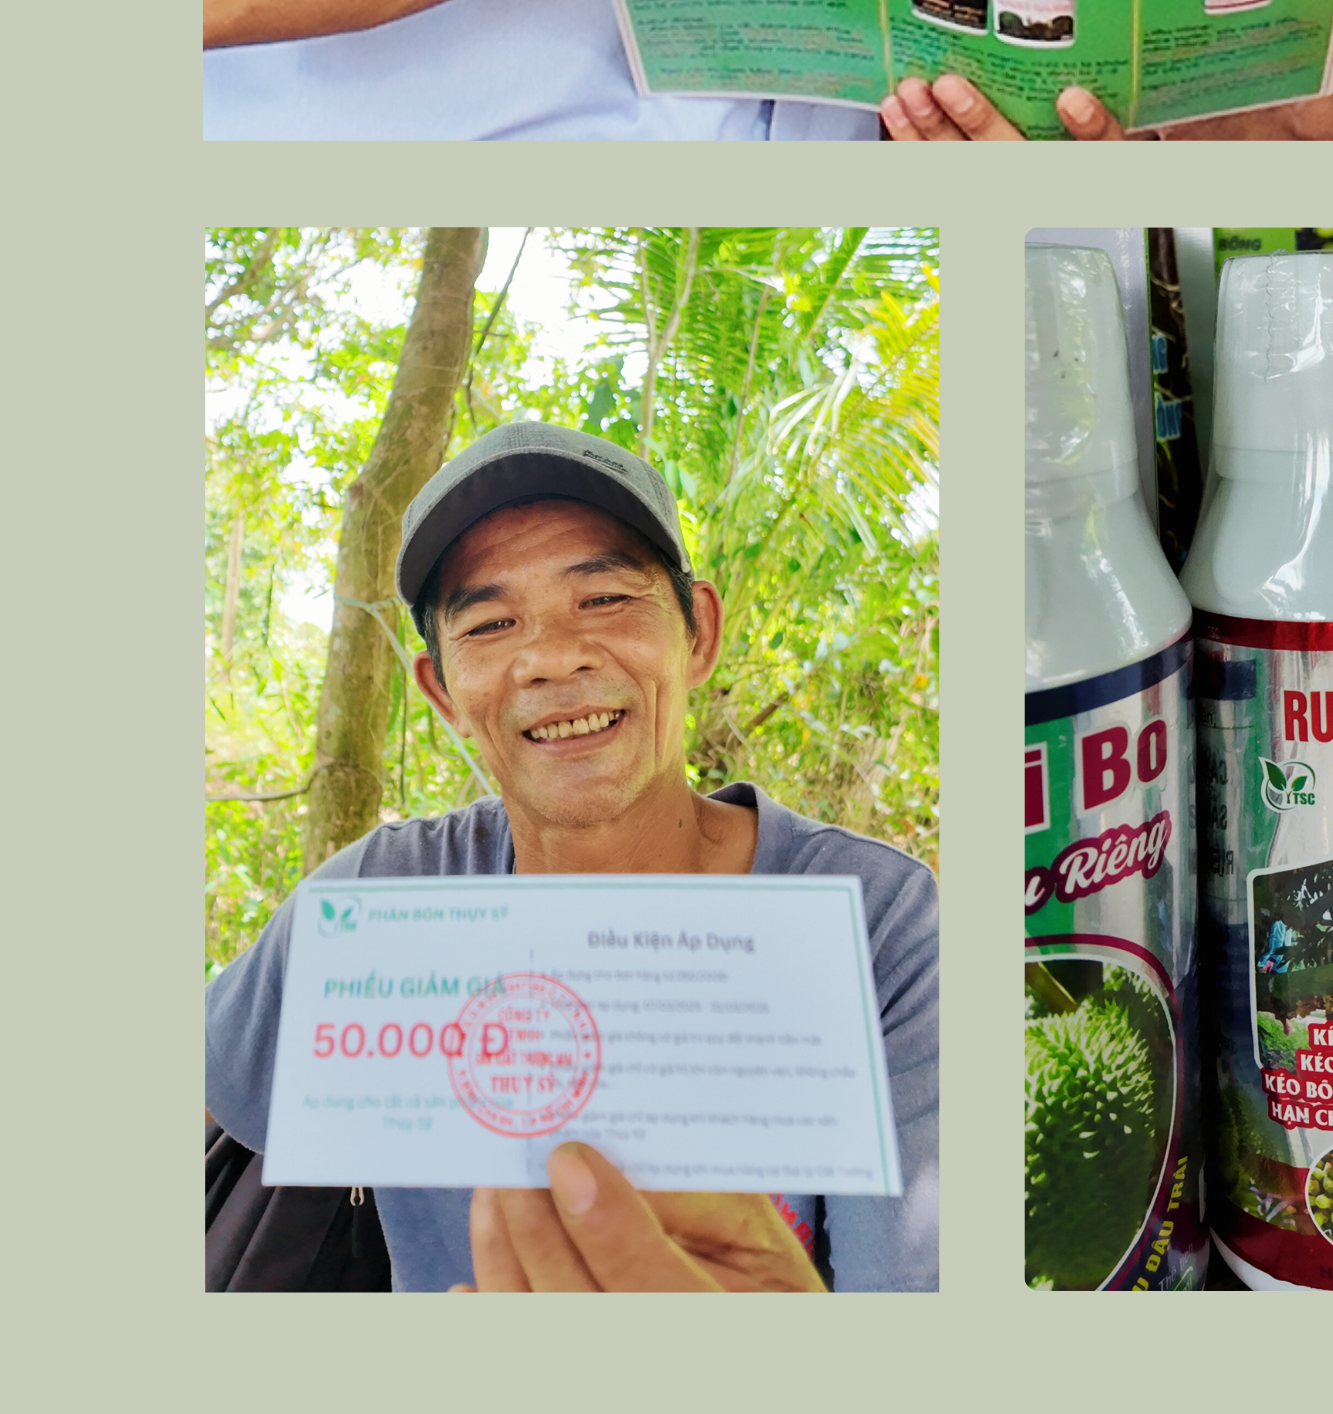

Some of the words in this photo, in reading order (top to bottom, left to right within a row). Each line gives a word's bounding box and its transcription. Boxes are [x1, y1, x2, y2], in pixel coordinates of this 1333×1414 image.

[1059, 818, 1167, 894] Riêng
[323, 969, 395, 999] PHIẾU
[400, 970, 460, 998] GIẢM
[312, 1022, 467, 1059] 50.000
[479, 1022, 510, 1059] Đ
[1264, 1072, 1300, 1096] KÉO
[1272, 1101, 1310, 1125] HẠN
[1166, 1154, 1189, 1213] TRÁI
[1144, 1218, 1175, 1275] ĐẬU
